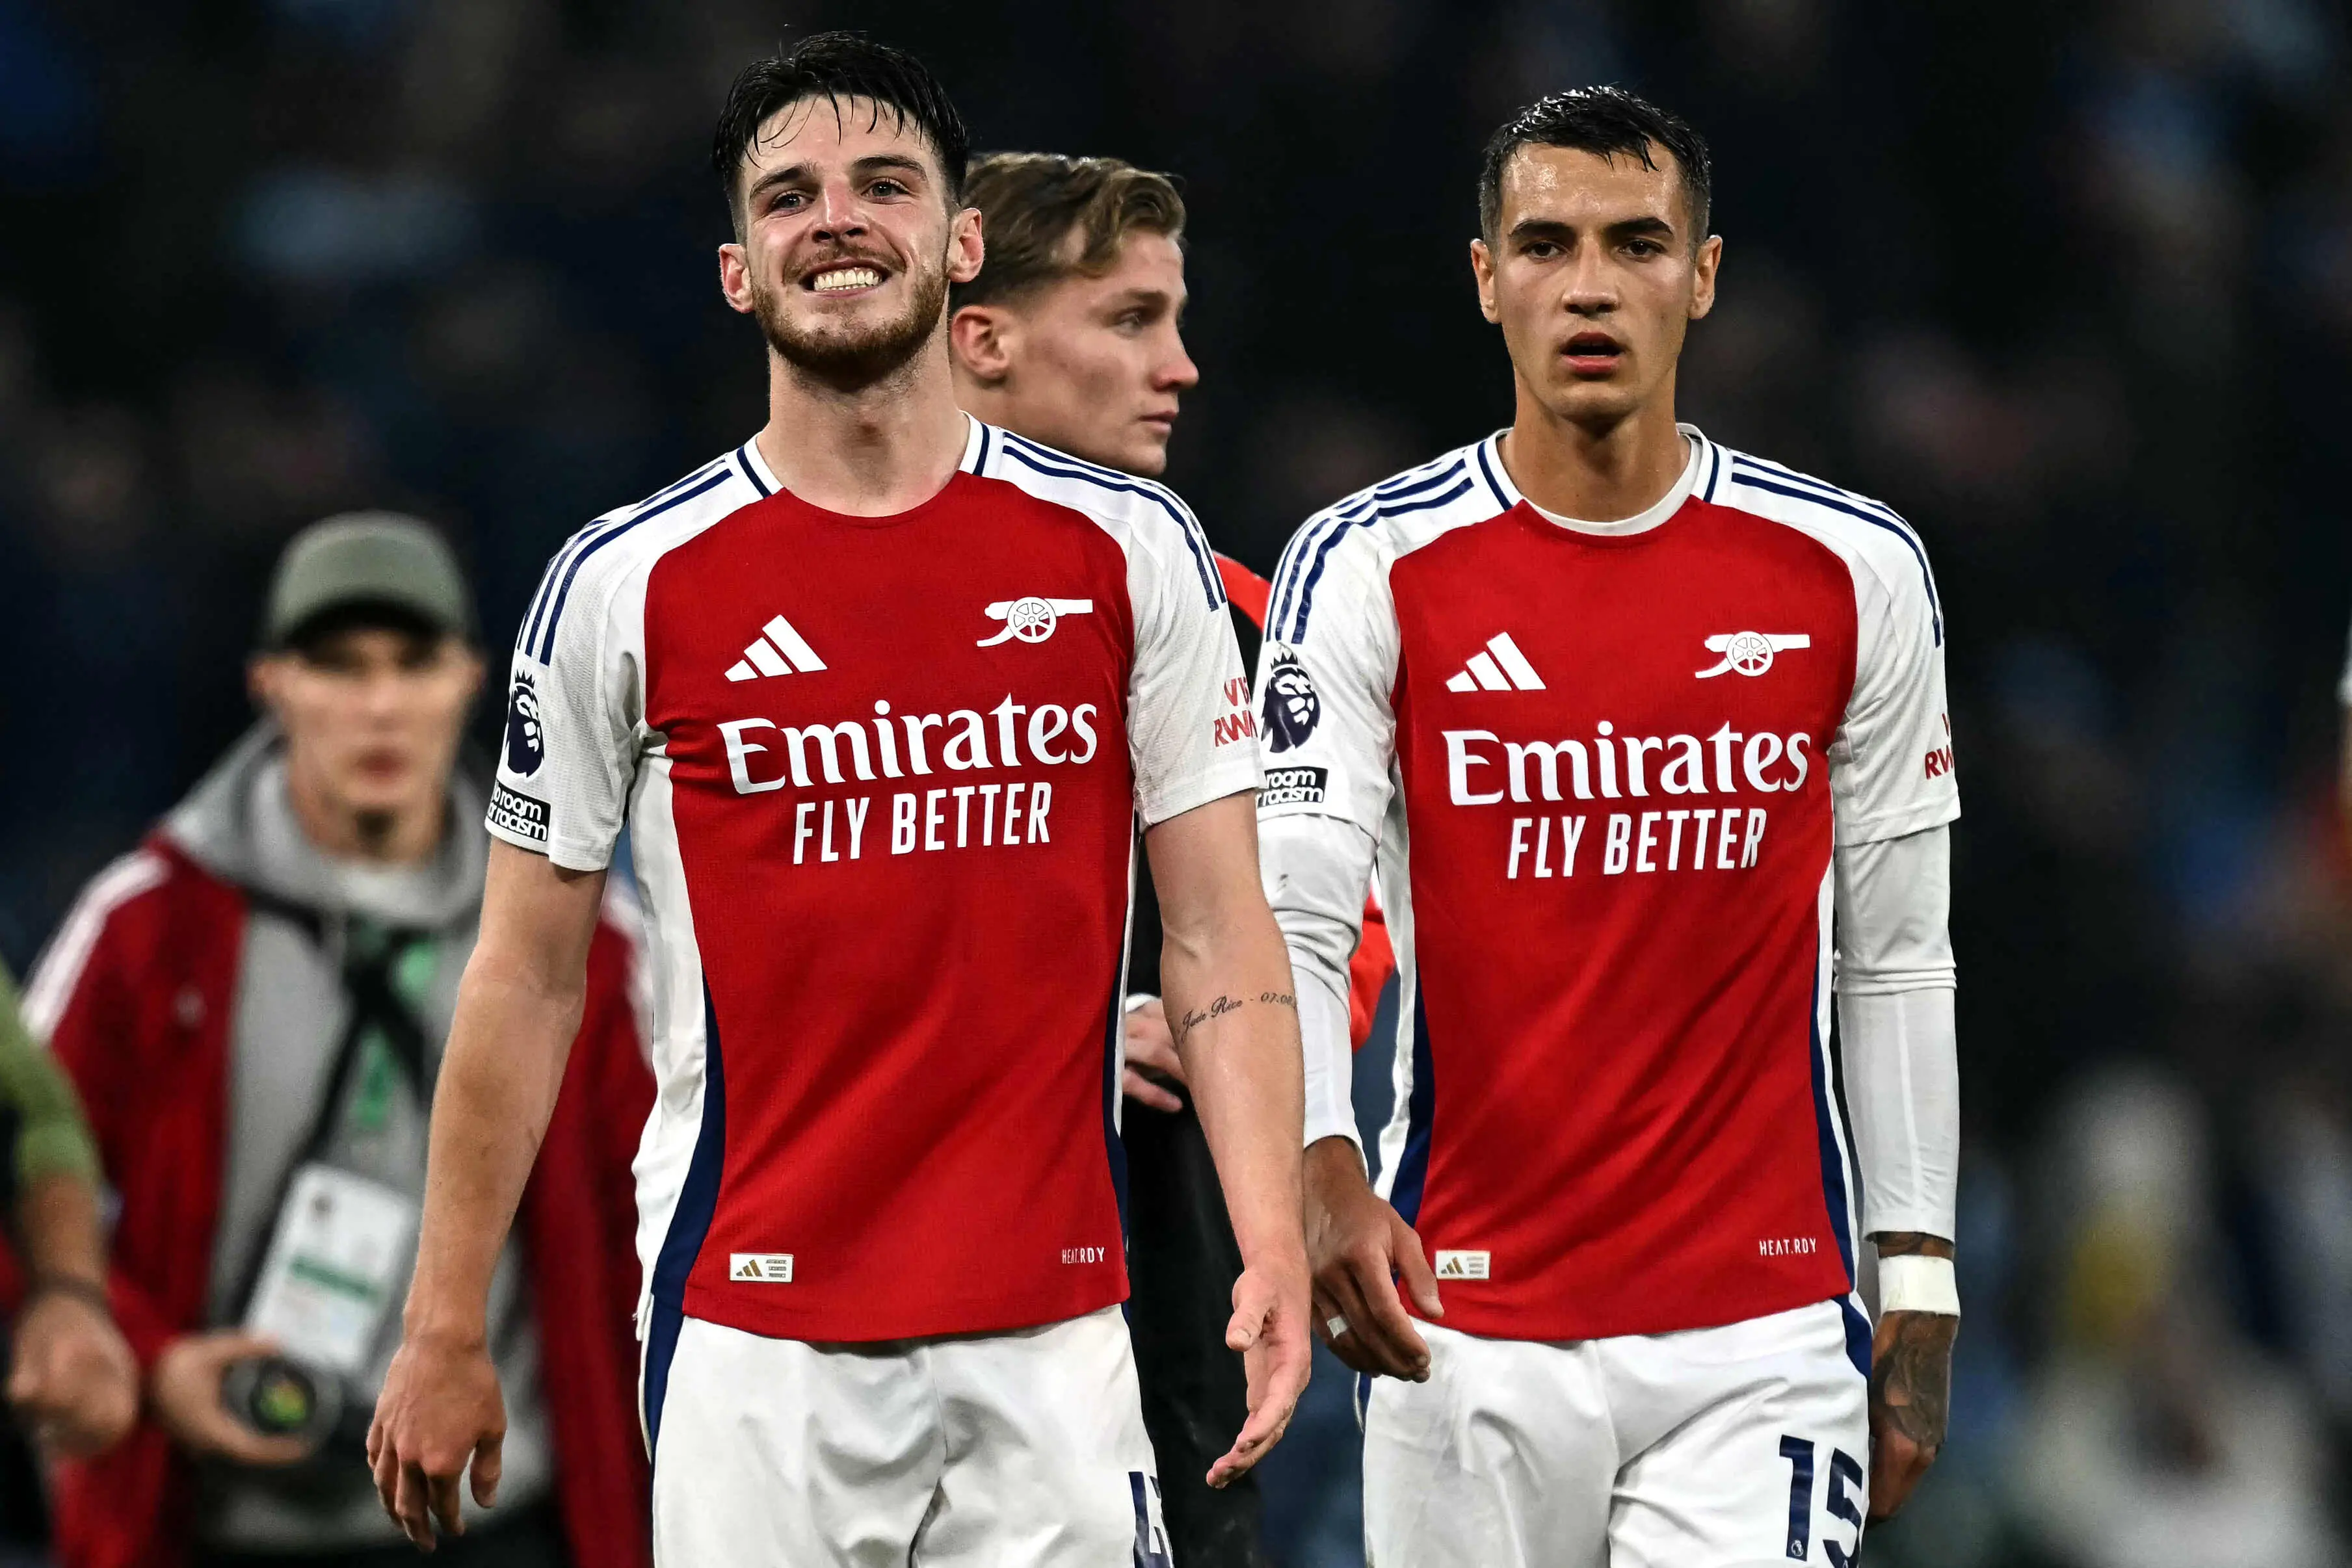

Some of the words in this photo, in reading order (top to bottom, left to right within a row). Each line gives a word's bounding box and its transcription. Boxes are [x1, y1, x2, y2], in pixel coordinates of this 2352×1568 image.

[717, 692, 1097, 794] Emirates
[1442, 720, 1810, 805] Emirates
[499, 791, 542, 821] room
[1263, 787, 1324, 806] racism
[495, 807, 547, 841] racism
[793, 797, 870, 865] FLY
[891, 782, 1052, 856] BETTER
[1507, 815, 1586, 879] FLY
[1603, 808, 1767, 875] BETTER
[1211, 995, 1243, 1018] Rice
[1062, 1247, 1105, 1264] HEAT.RDY
[1759, 1237, 1816, 1256] HEAT.RDY
[1779, 1434, 1864, 1568] 15
